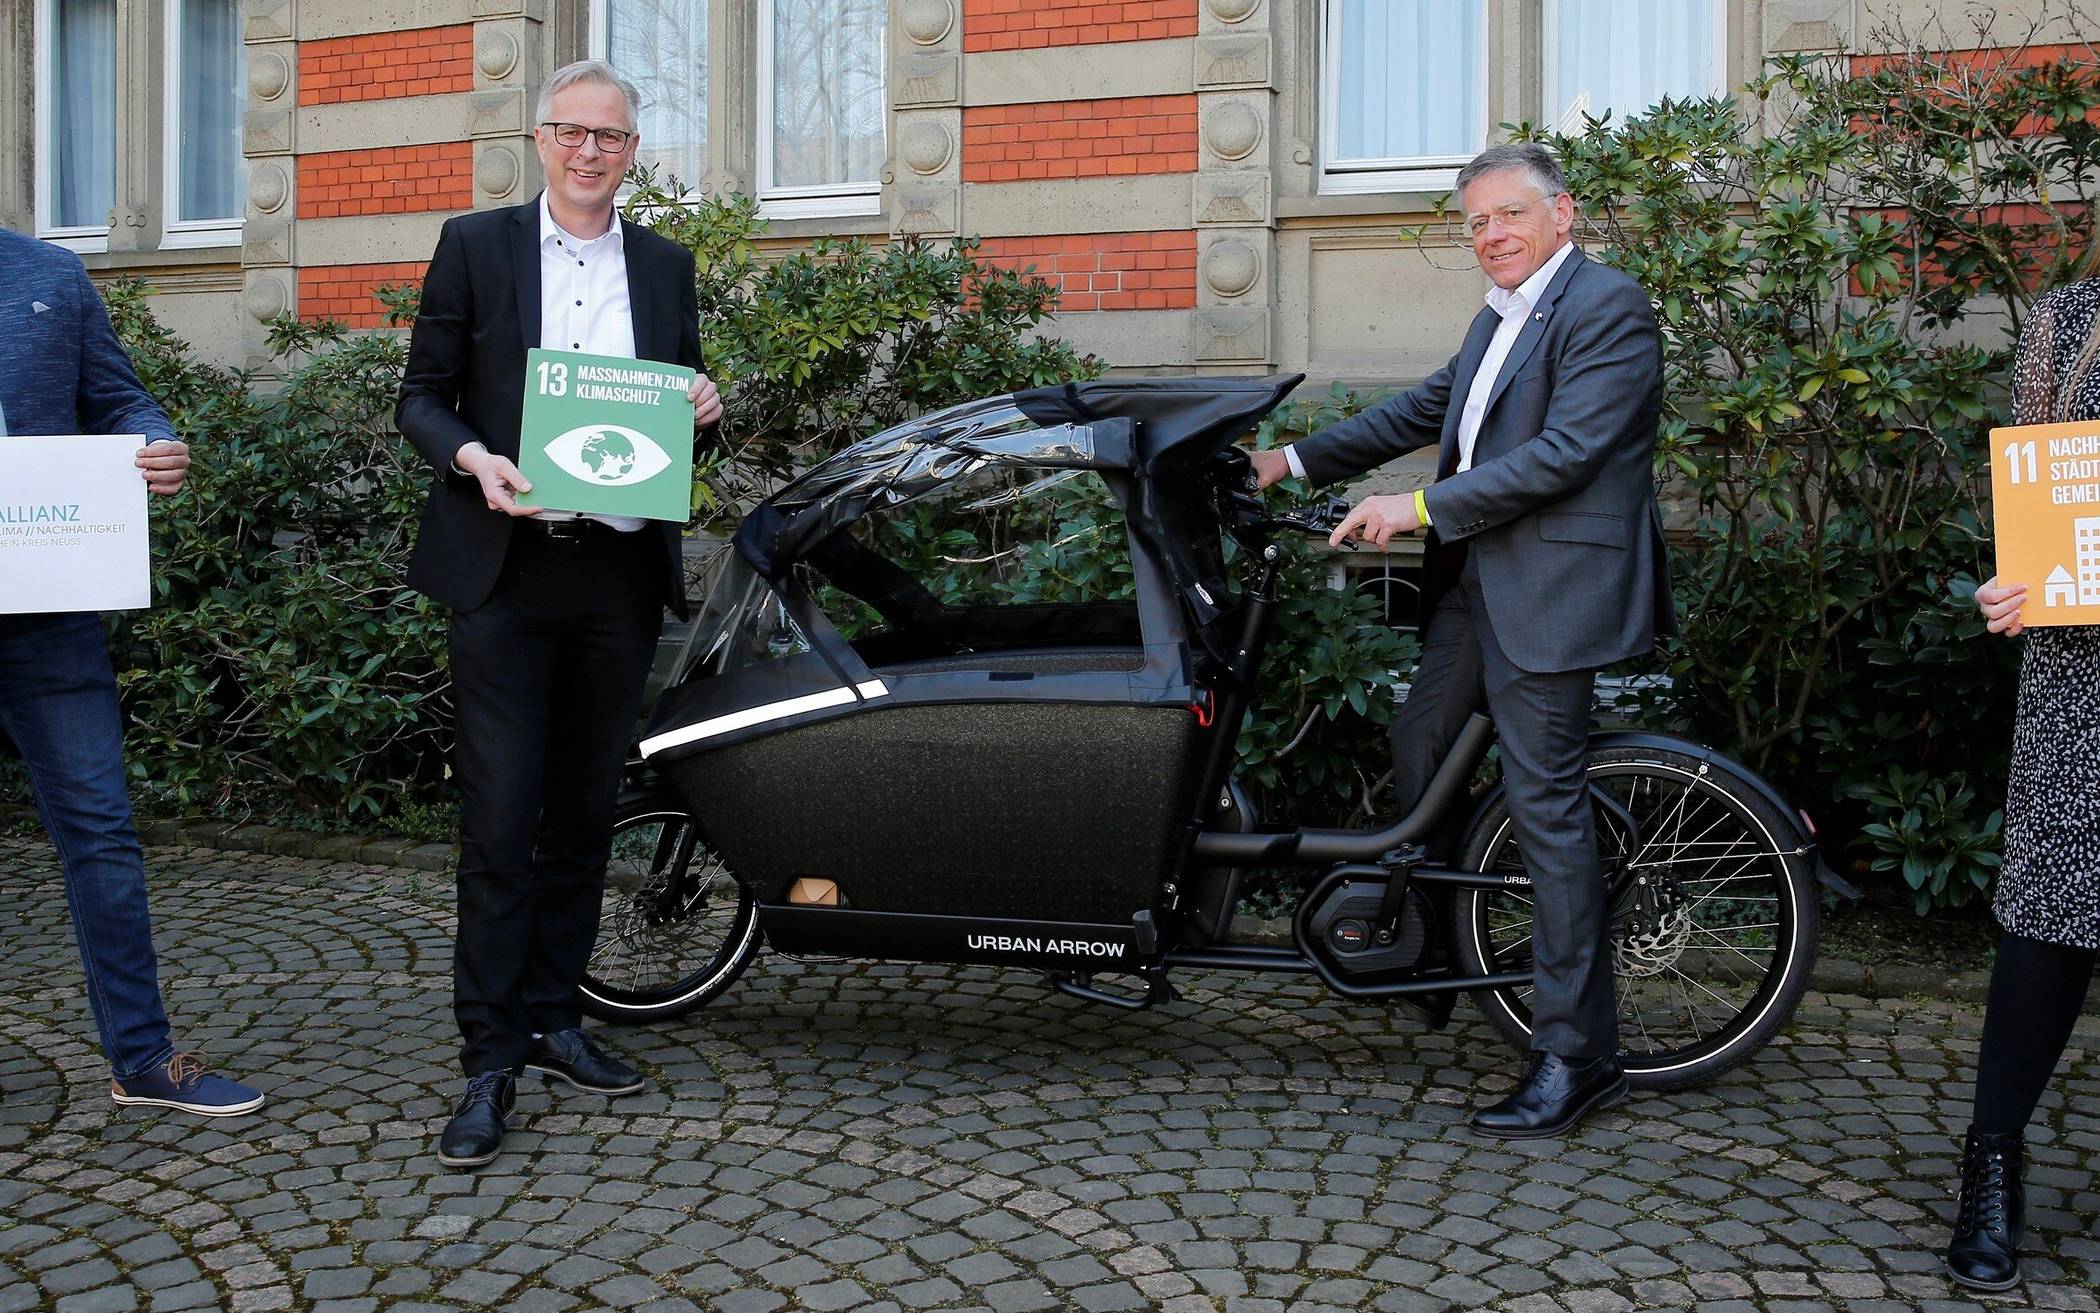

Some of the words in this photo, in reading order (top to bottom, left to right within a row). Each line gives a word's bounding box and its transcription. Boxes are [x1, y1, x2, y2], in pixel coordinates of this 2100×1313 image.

[536, 361, 569, 397] 13
[577, 365, 663, 388] MASSNAHMEN
[664, 374, 690, 393] ZUM
[576, 384, 661, 406] KLIMASCHUTZ
[2048, 436, 2100, 457] NACHH
[2004, 440, 2038, 485] 11
[2050, 458, 2100, 481] STÄDT
[2052, 483, 2100, 505] GEMEI
[37, 523, 126, 536] NACHHALTIGKEIT
[51, 537, 82, 547] NEUSS
[967, 934, 1041, 953] URBAN
[1045, 938, 1126, 958] ARROW
